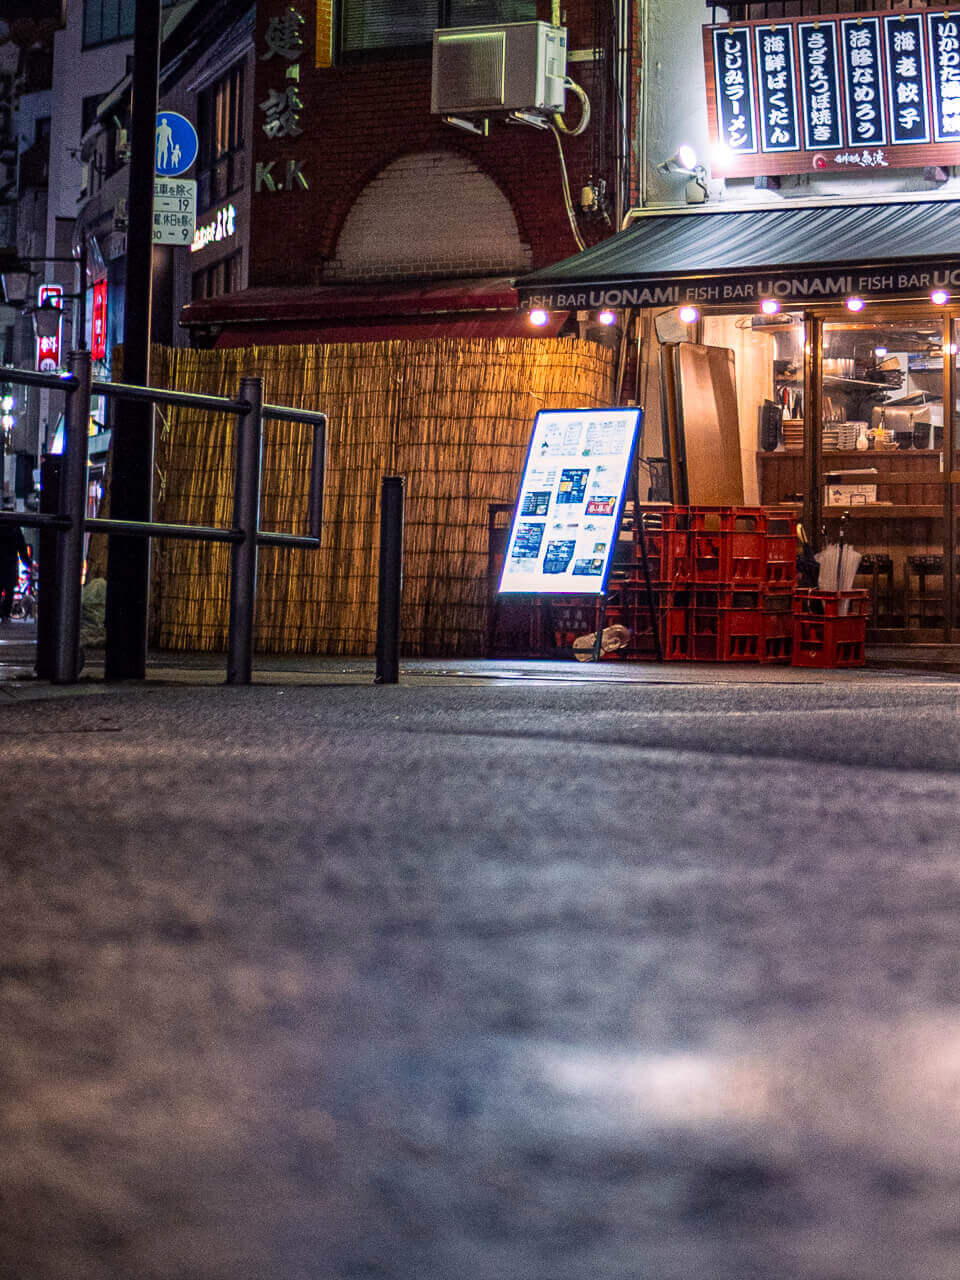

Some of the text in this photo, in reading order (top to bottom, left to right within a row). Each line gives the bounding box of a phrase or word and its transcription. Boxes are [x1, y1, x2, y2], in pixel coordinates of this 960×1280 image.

[724, 38, 748, 147] しじみラーメン
[763, 35, 790, 144] 海鮮ばくだん
[178, 199, 189, 212] 19
[181, 229, 189, 241] 9
[557, 294, 587, 308] BAR
[589, 286, 680, 308] UONAMI
[686, 287, 719, 301] FISH
[723, 284, 755, 299] BAR
[757, 276, 852, 298] UONAMI
[858, 275, 894, 292] FISH
[898, 273, 931, 289] BAR
